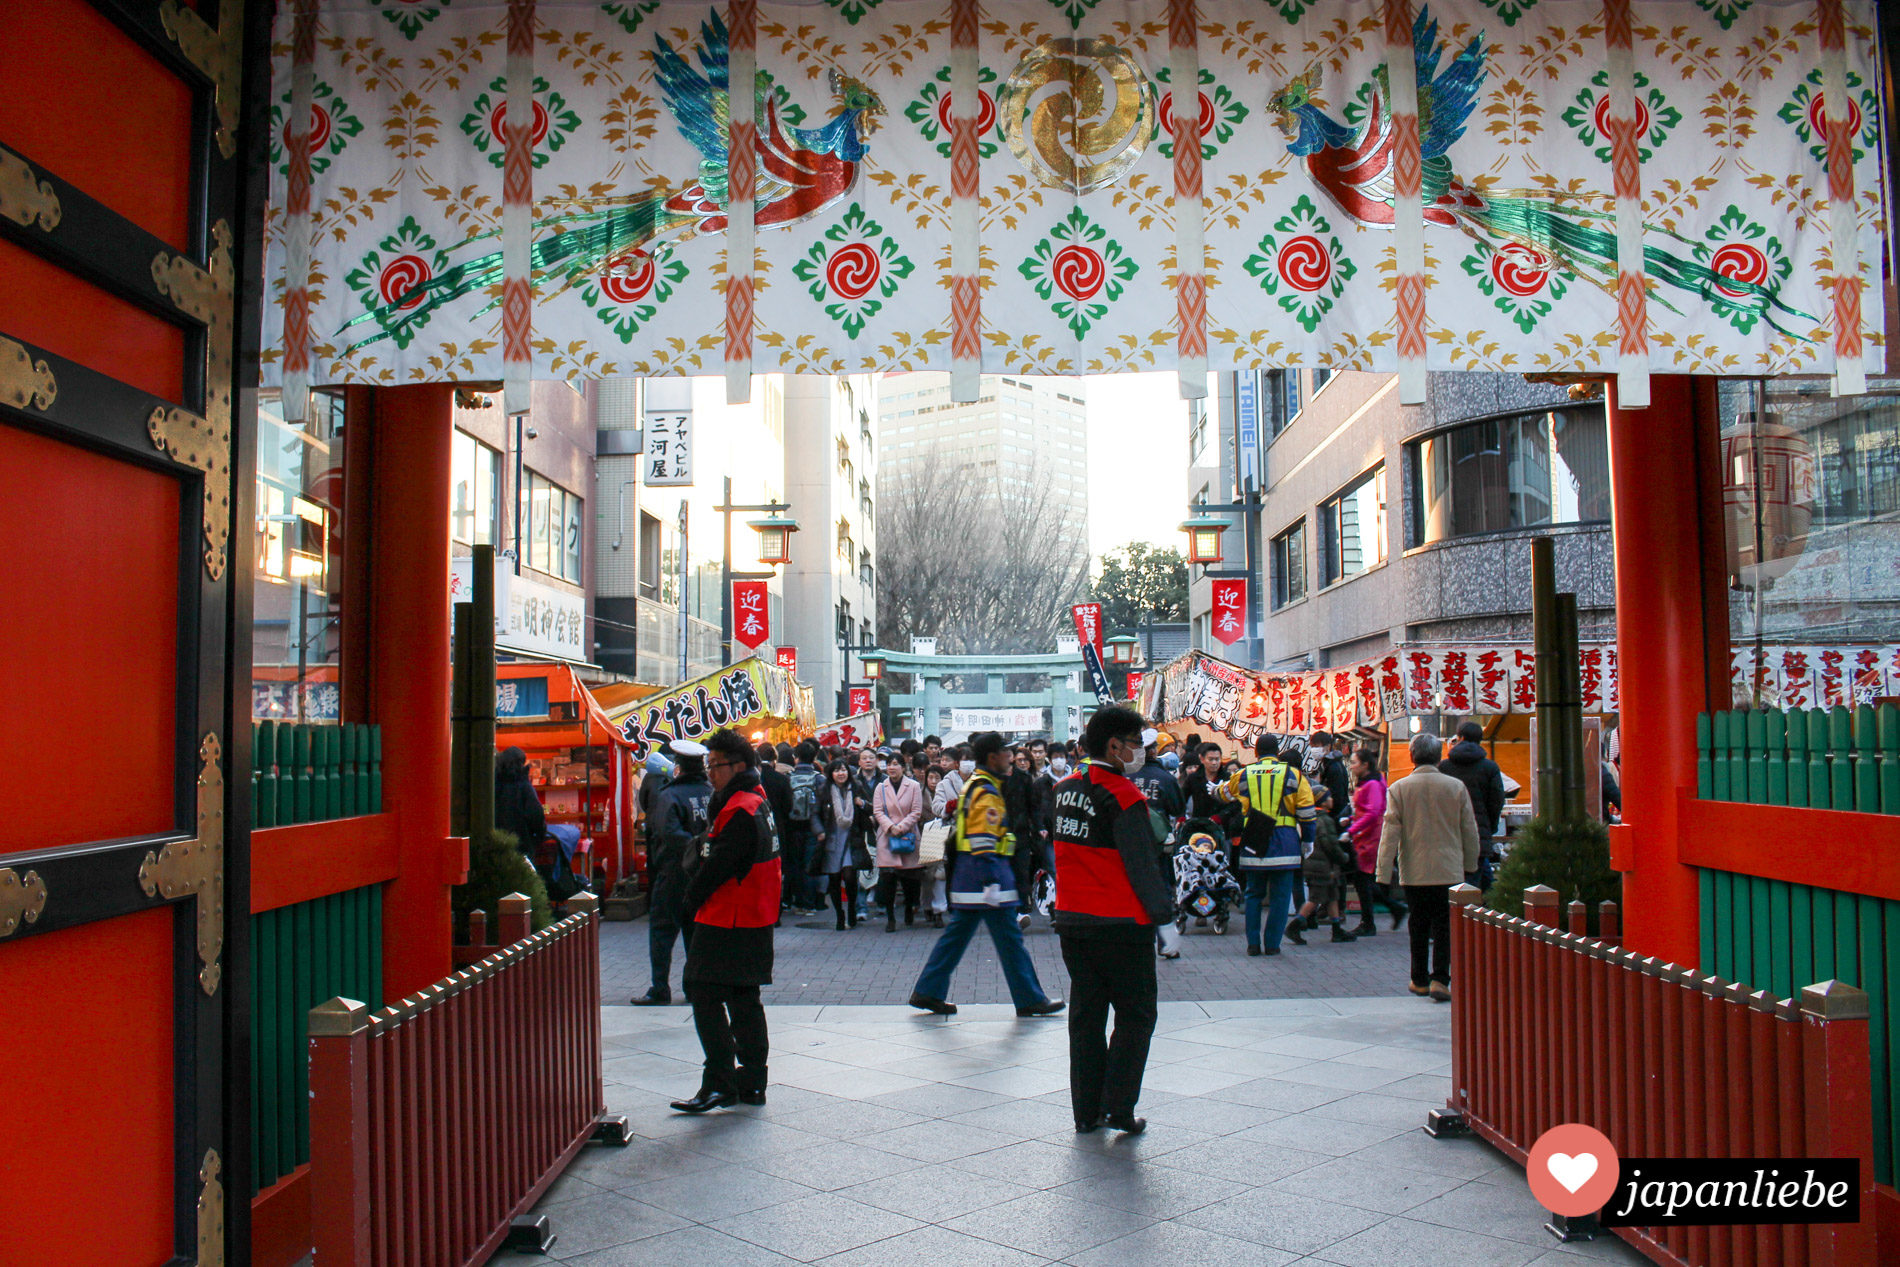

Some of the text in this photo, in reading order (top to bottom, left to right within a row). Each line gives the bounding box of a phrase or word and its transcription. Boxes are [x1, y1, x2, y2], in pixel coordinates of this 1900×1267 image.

[1241, 382, 1255, 447] TAIMEI
[650, 417, 669, 478] 三河屋
[674, 416, 688, 477] アヤベビル
[524, 597, 581, 646] 明神会館
[740, 589, 763, 635] 迎春
[1217, 587, 1240, 633] 迎春
[1440, 651, 1470, 710] お好み焼
[1476, 650, 1506, 709] チヂミ
